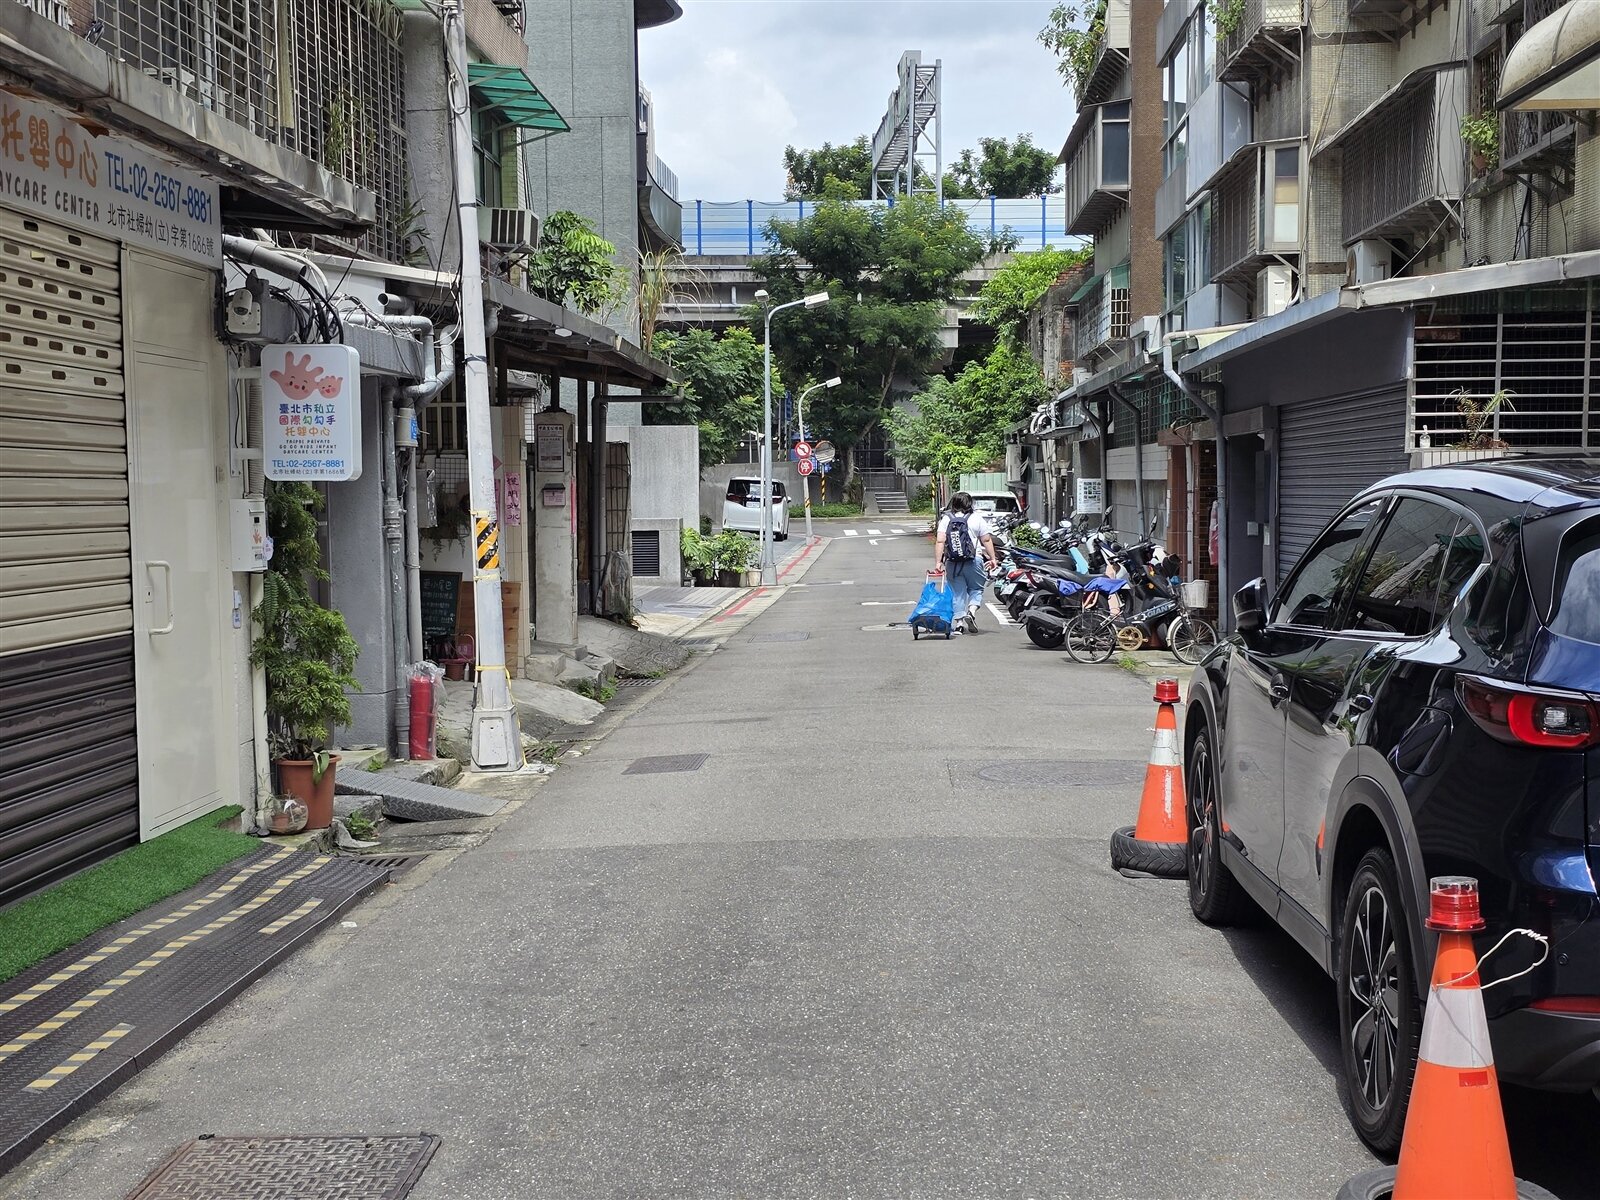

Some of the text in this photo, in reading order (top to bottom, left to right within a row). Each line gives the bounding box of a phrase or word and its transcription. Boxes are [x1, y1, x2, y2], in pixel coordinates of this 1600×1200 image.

[1, 103, 98, 188] 托嬰中心
[105, 151, 213, 225] TEL:02-2567-8881
[54, 190, 100, 222] CENTER
[279, 403, 336, 414] 臺北市私立
[279, 415, 336, 425] 國際勾勾手
[285, 426, 331, 437] 托嬰中心
[1147, 604, 1172, 617] GIANT
